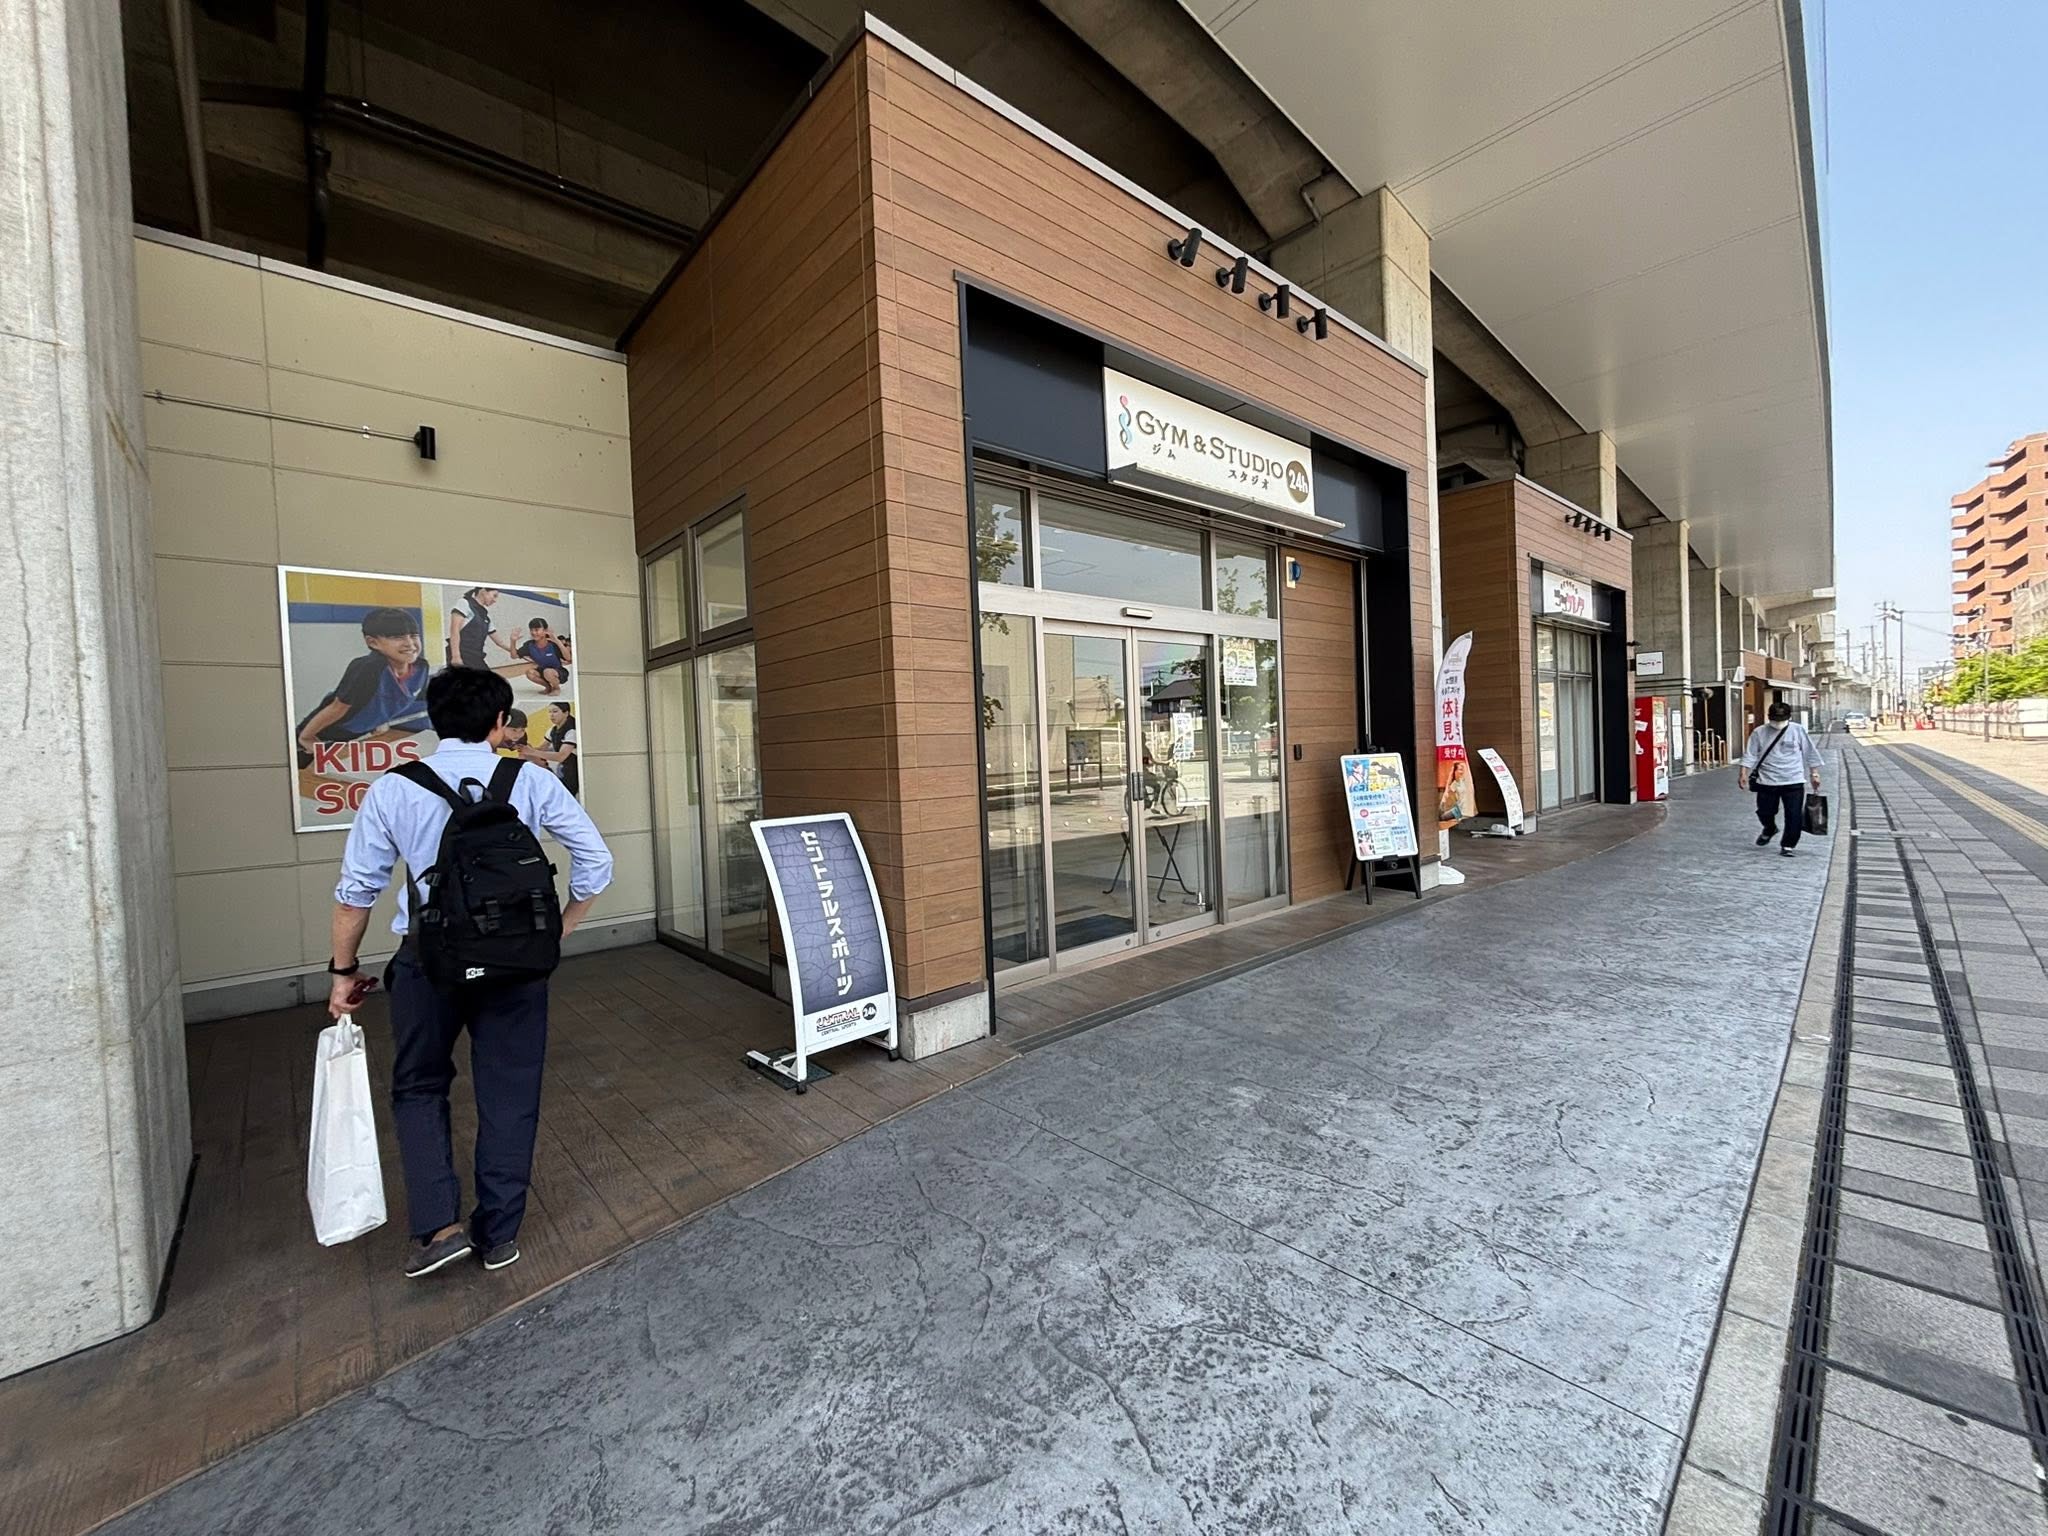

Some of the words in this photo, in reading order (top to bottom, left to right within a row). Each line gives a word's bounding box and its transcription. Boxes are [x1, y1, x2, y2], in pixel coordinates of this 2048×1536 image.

[1136, 410, 1189, 449] GYM
[1210, 436, 1284, 479] STUDIO
[1288, 468, 1309, 493] 24h
[1228, 469, 1270, 490] スタジオ
[800, 830, 854, 996] セントラルスポーツ
